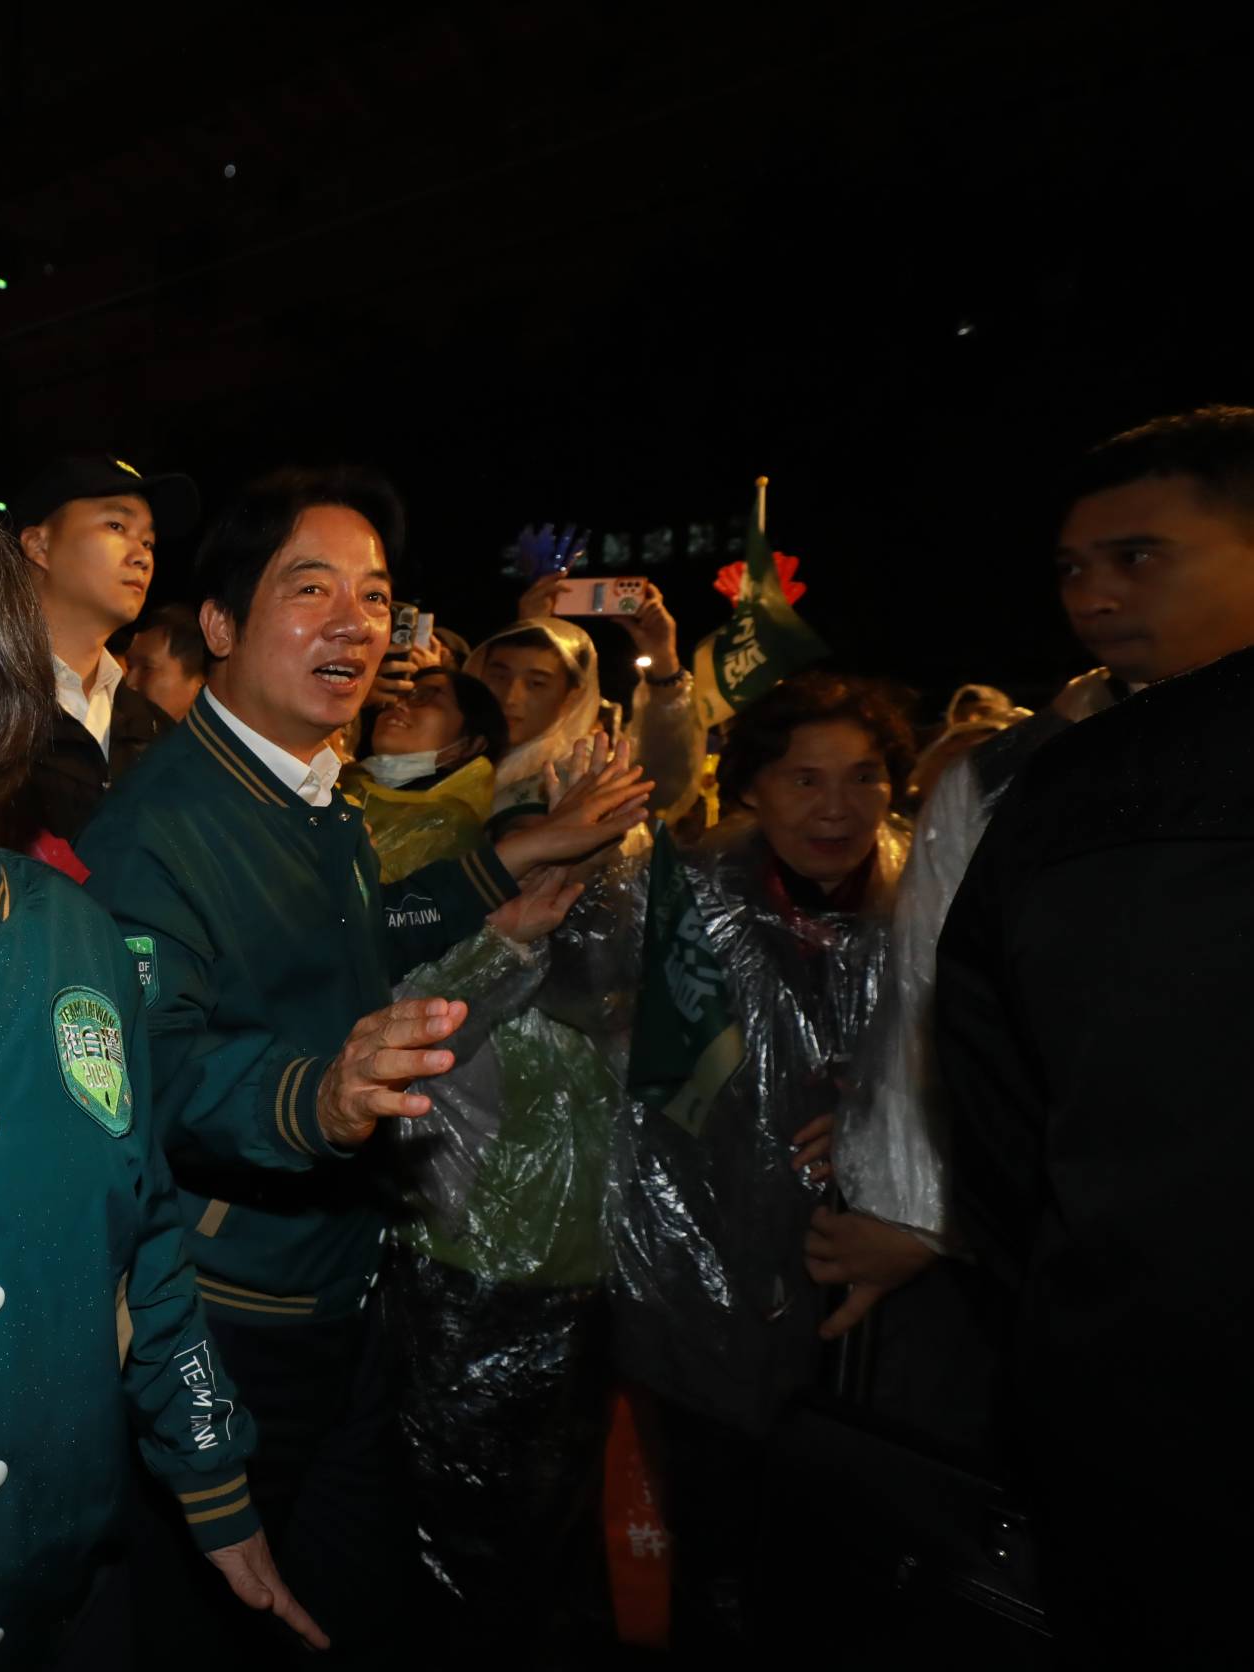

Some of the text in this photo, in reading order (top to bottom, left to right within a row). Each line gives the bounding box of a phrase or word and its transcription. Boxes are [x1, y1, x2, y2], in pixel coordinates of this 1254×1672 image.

[386, 912, 407, 928] AM
[58, 1001, 83, 1025] TEAM
[82, 1062, 117, 1089] 2024
